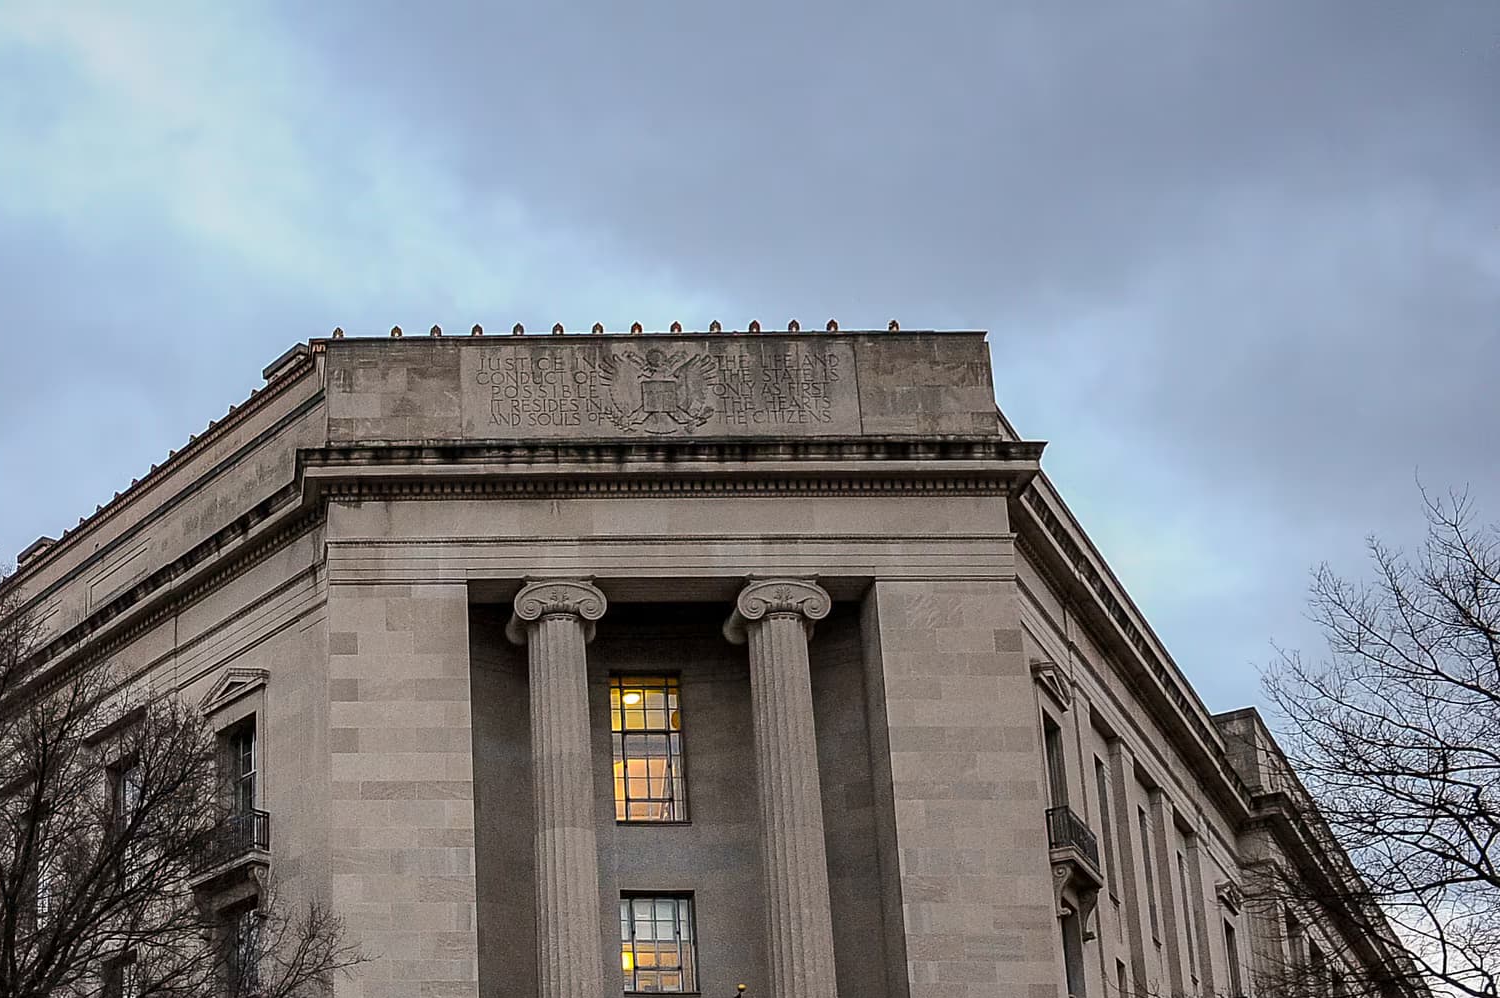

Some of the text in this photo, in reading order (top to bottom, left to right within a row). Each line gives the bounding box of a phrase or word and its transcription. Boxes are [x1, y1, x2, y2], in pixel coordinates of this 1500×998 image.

[477, 353, 839, 371] JUSTICE IN THE LIFE AND
[476, 368, 840, 385] CONDUCT OF THE STATE IS
[491, 382, 831, 399] POSSIBLE ONLY AS FIRST
[490, 396, 832, 413] IT RESIDES IN THE HEARTS
[488, 410, 834, 427] AND SOULS OF THE CITIZENS.
